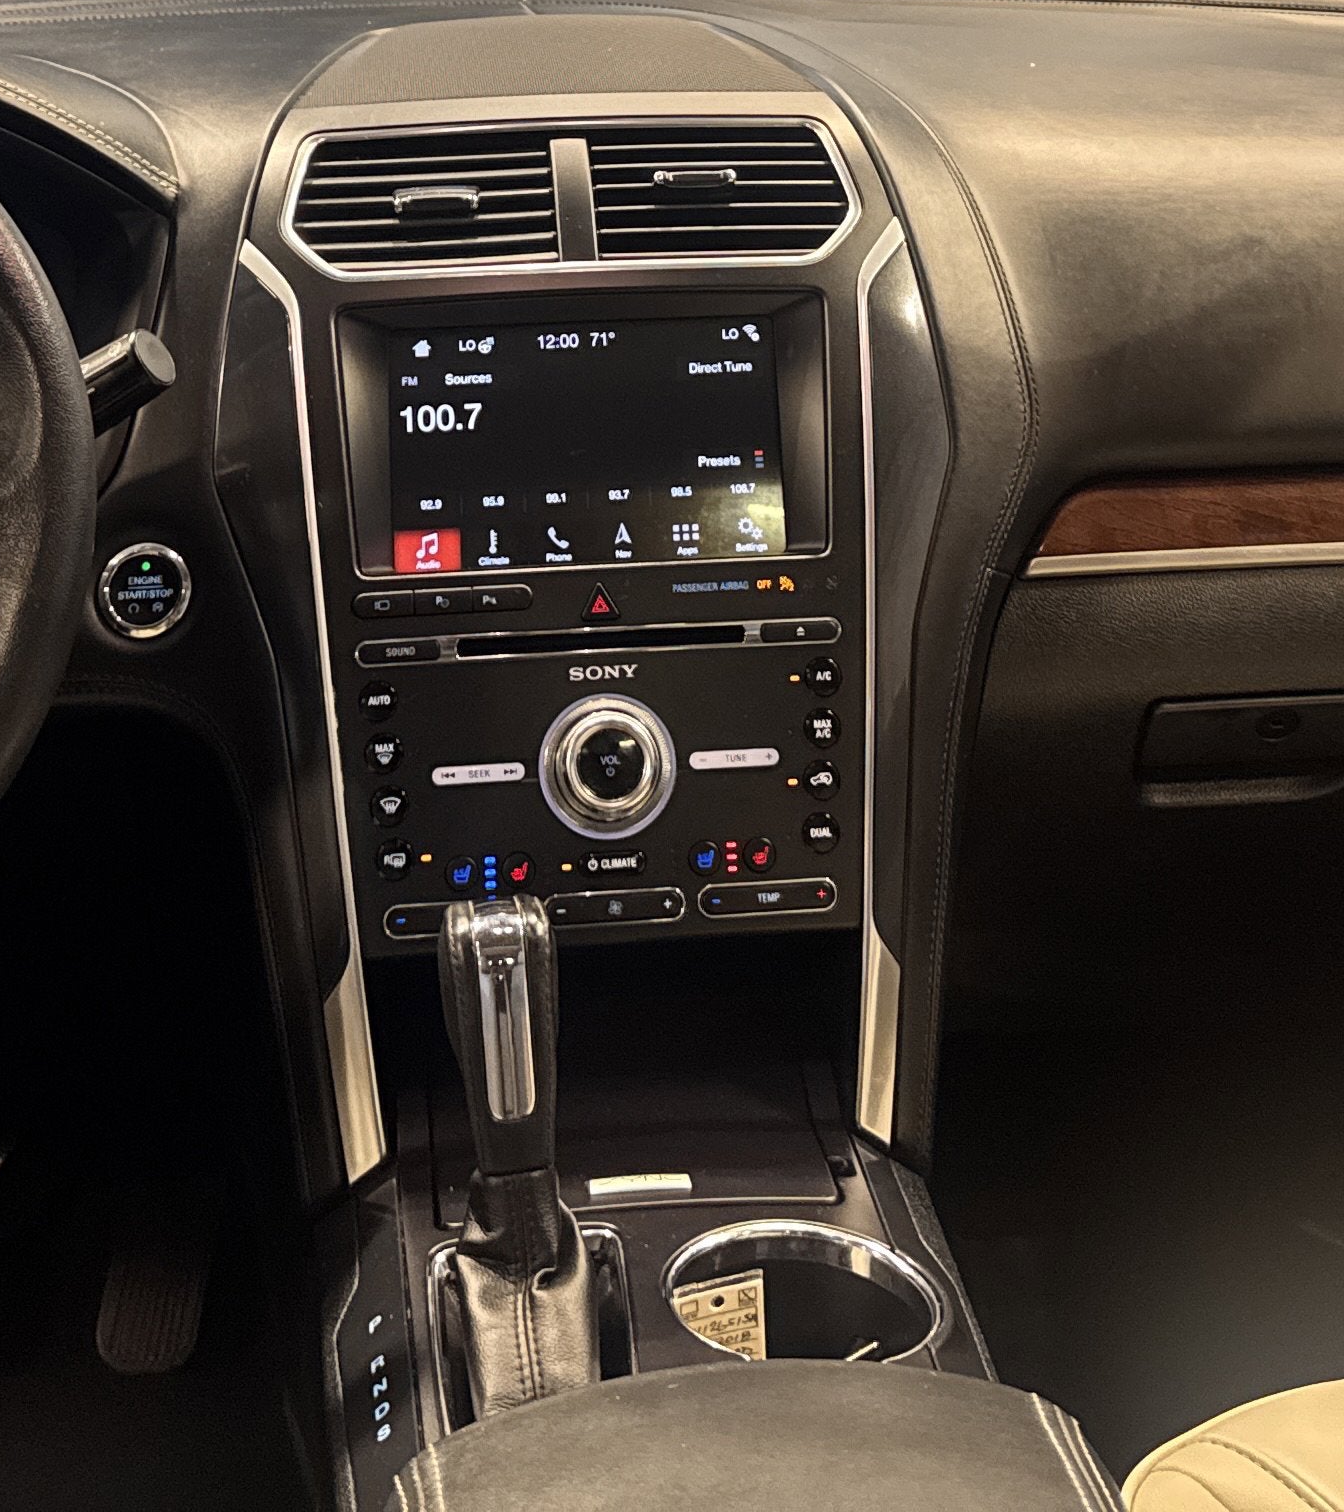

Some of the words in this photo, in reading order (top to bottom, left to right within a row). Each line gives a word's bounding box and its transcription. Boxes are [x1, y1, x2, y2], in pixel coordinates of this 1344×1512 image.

[721, 328, 740, 340] LO
[458, 339, 477, 352] LO
[536, 333, 580, 350] 12:00
[589, 331, 616, 347] 71°
[688, 361, 723, 375] Direct
[724, 360, 753, 373] Tune
[401, 376, 419, 387] FM
[444, 373, 493, 386] Sources
[399, 402, 482, 433] 100.7
[697, 455, 742, 468] Presets
[608, 489, 630, 501] 93.7
[676, 546, 699, 558] Apps
[735, 541, 769, 554] Settings
[545, 552, 573, 563] Phone
[614, 549, 633, 560] Nav
[416, 559, 442, 571] Audio
[478, 556, 510, 567] Climate
[127, 575, 164, 586] ENGINE
[672, 582, 719, 593] PASSENGER
[720, 580, 750, 591] AIRBAG
[756, 579, 772, 589] OFF
[117, 588, 174, 601] START/STOP
[385, 646, 416, 658] SOUND
[568, 664, 639, 681] SONY
[815, 671, 832, 682] A/C
[367, 694, 391, 706] AUTO
[813, 718, 833, 729] MAX
[815, 728, 832, 739] A/C
[375, 742, 395, 753] MAX
[600, 755, 621, 766] VOL
[725, 753, 748, 764] TUNE
[468, 769, 491, 779] SEEK
[809, 827, 833, 838] DUAL
[600, 857, 637, 869] CLIMATE
[757, 892, 781, 904] TEMP
[368, 1314, 382, 1334] P
[370, 1354, 385, 1374] R
[372, 1376, 388, 1399] N
[374, 1401, 391, 1421] D
[376, 1423, 392, 1442] S
